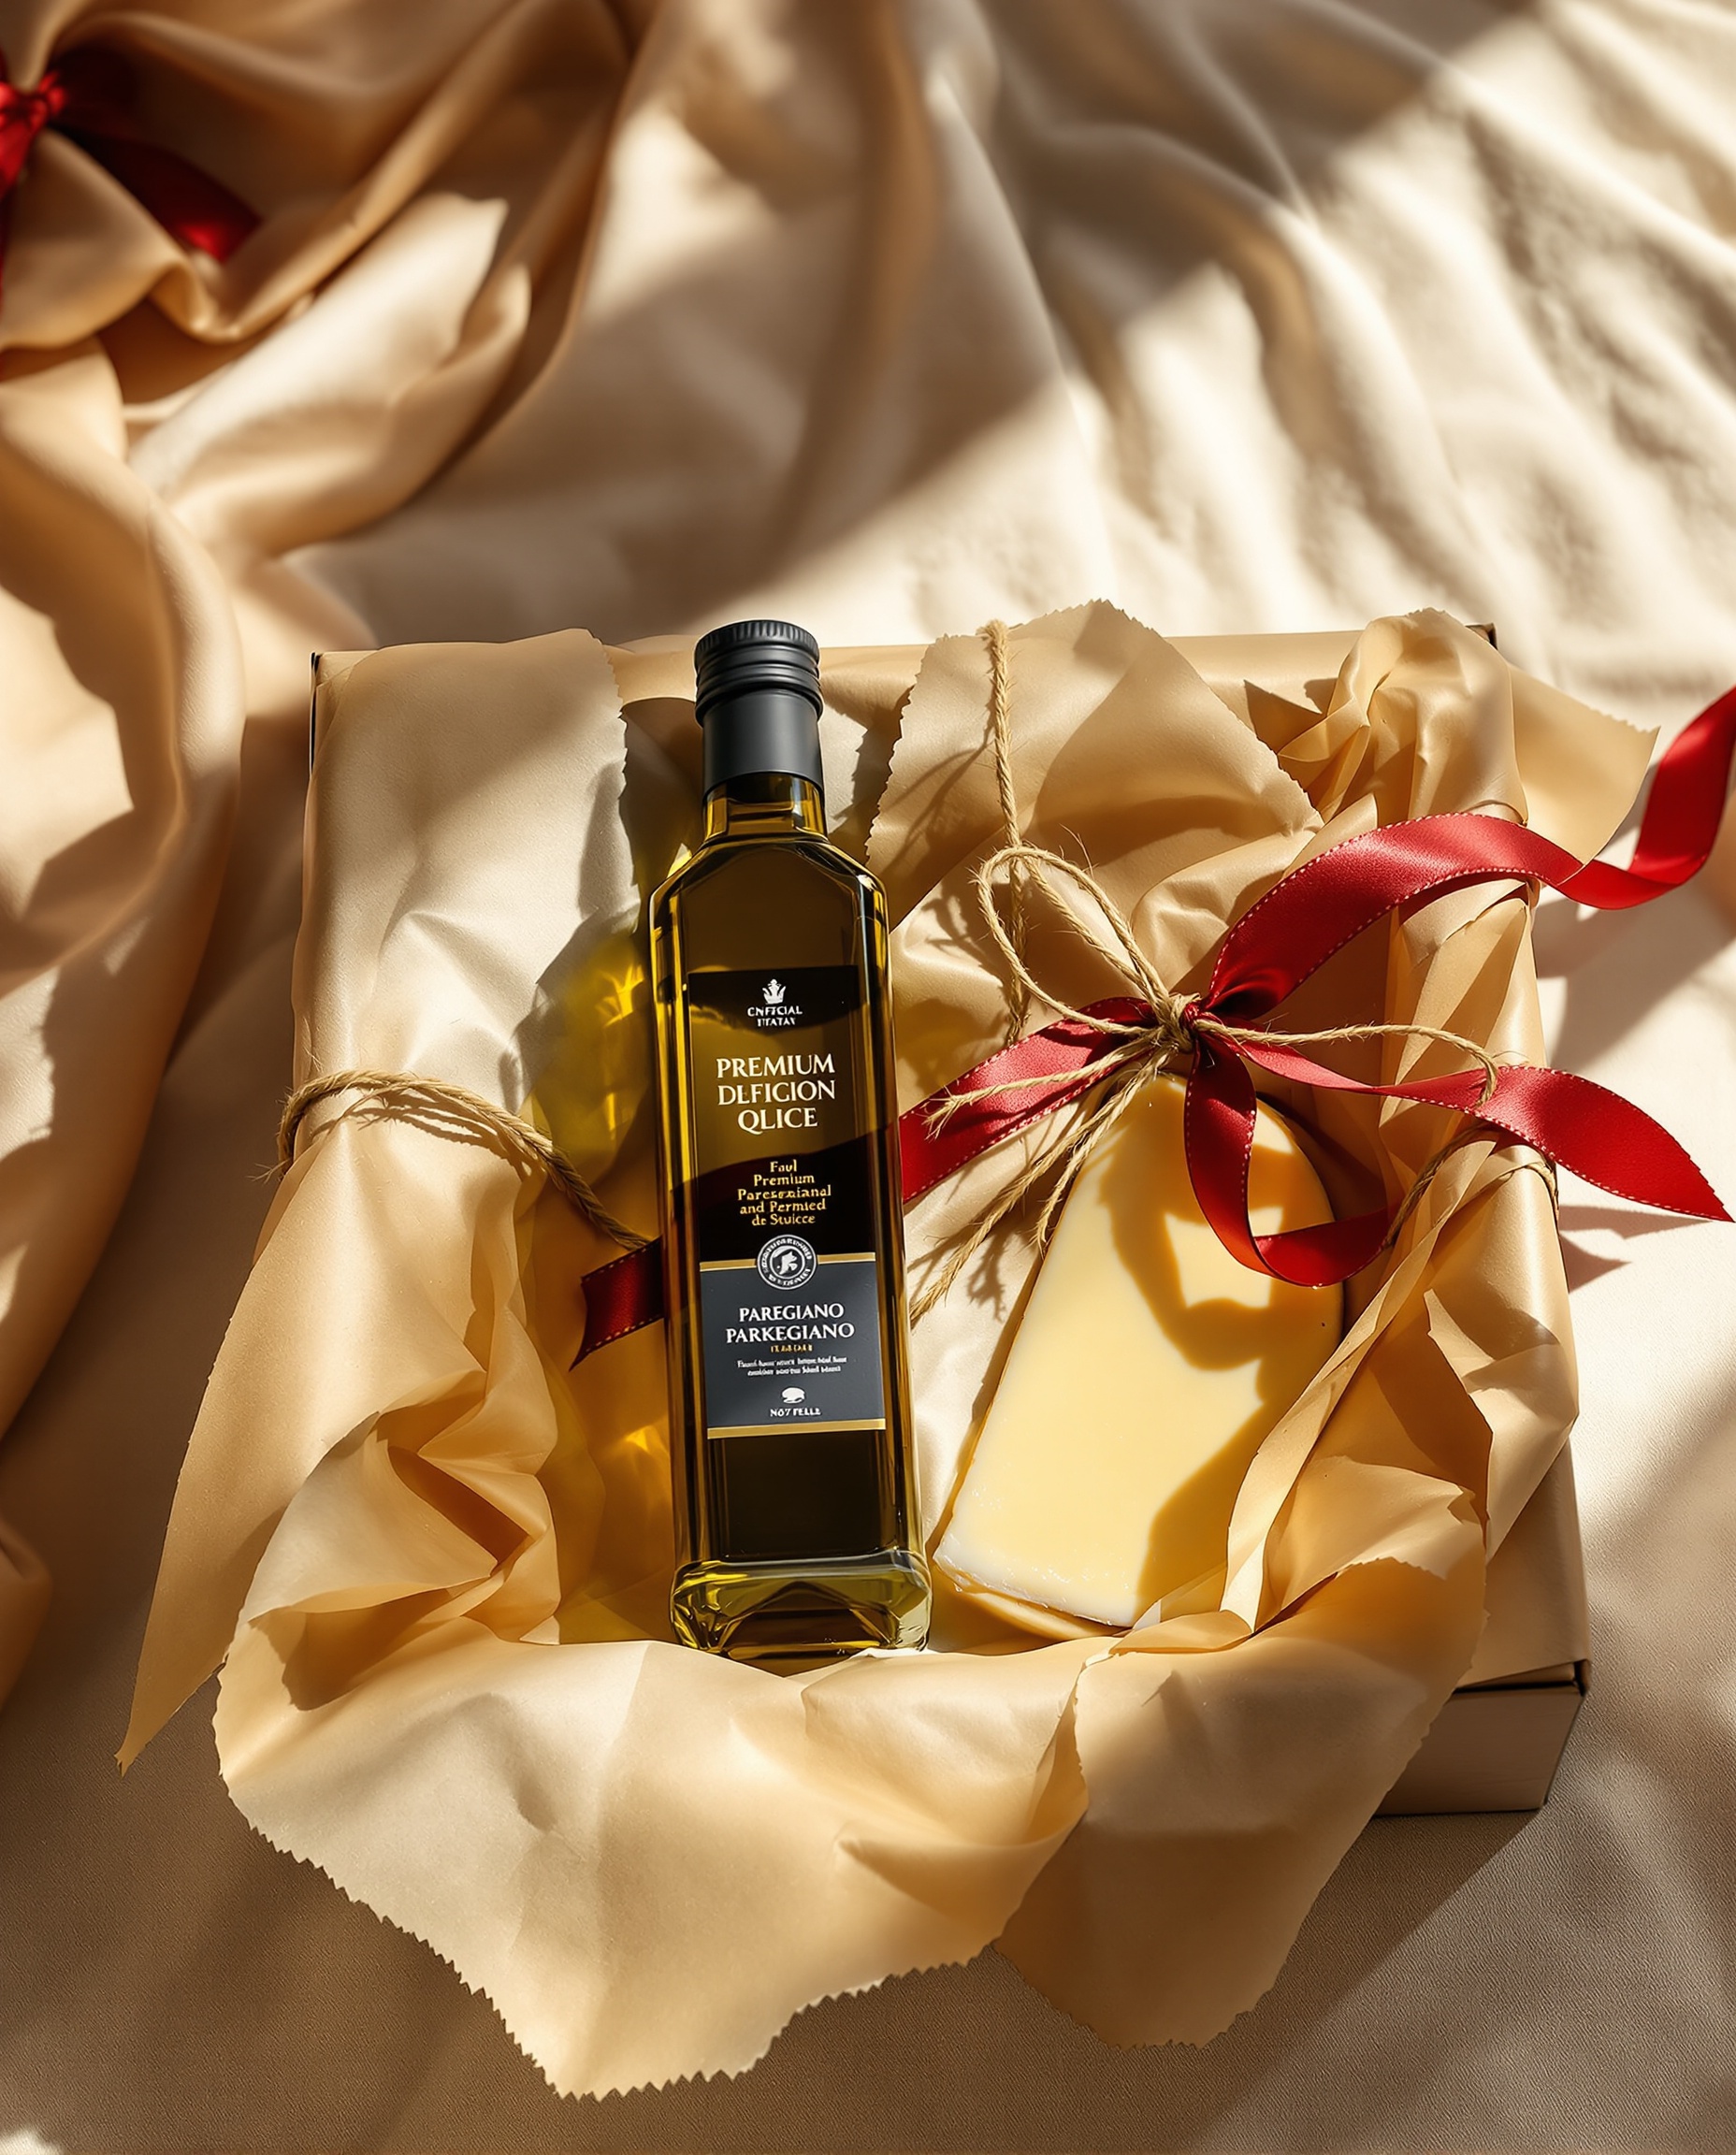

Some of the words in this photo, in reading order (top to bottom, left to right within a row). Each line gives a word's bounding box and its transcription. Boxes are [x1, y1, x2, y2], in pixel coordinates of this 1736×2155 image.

[716, 1053, 835, 1078] PREMIUM
[738, 1107, 818, 1135] QLICE
[754, 1173, 815, 1187] Premium
[740, 1201, 765, 1214] and
[739, 1303, 845, 1323] PAREGIANO
[726, 1323, 855, 1343] PARKEGIANO
